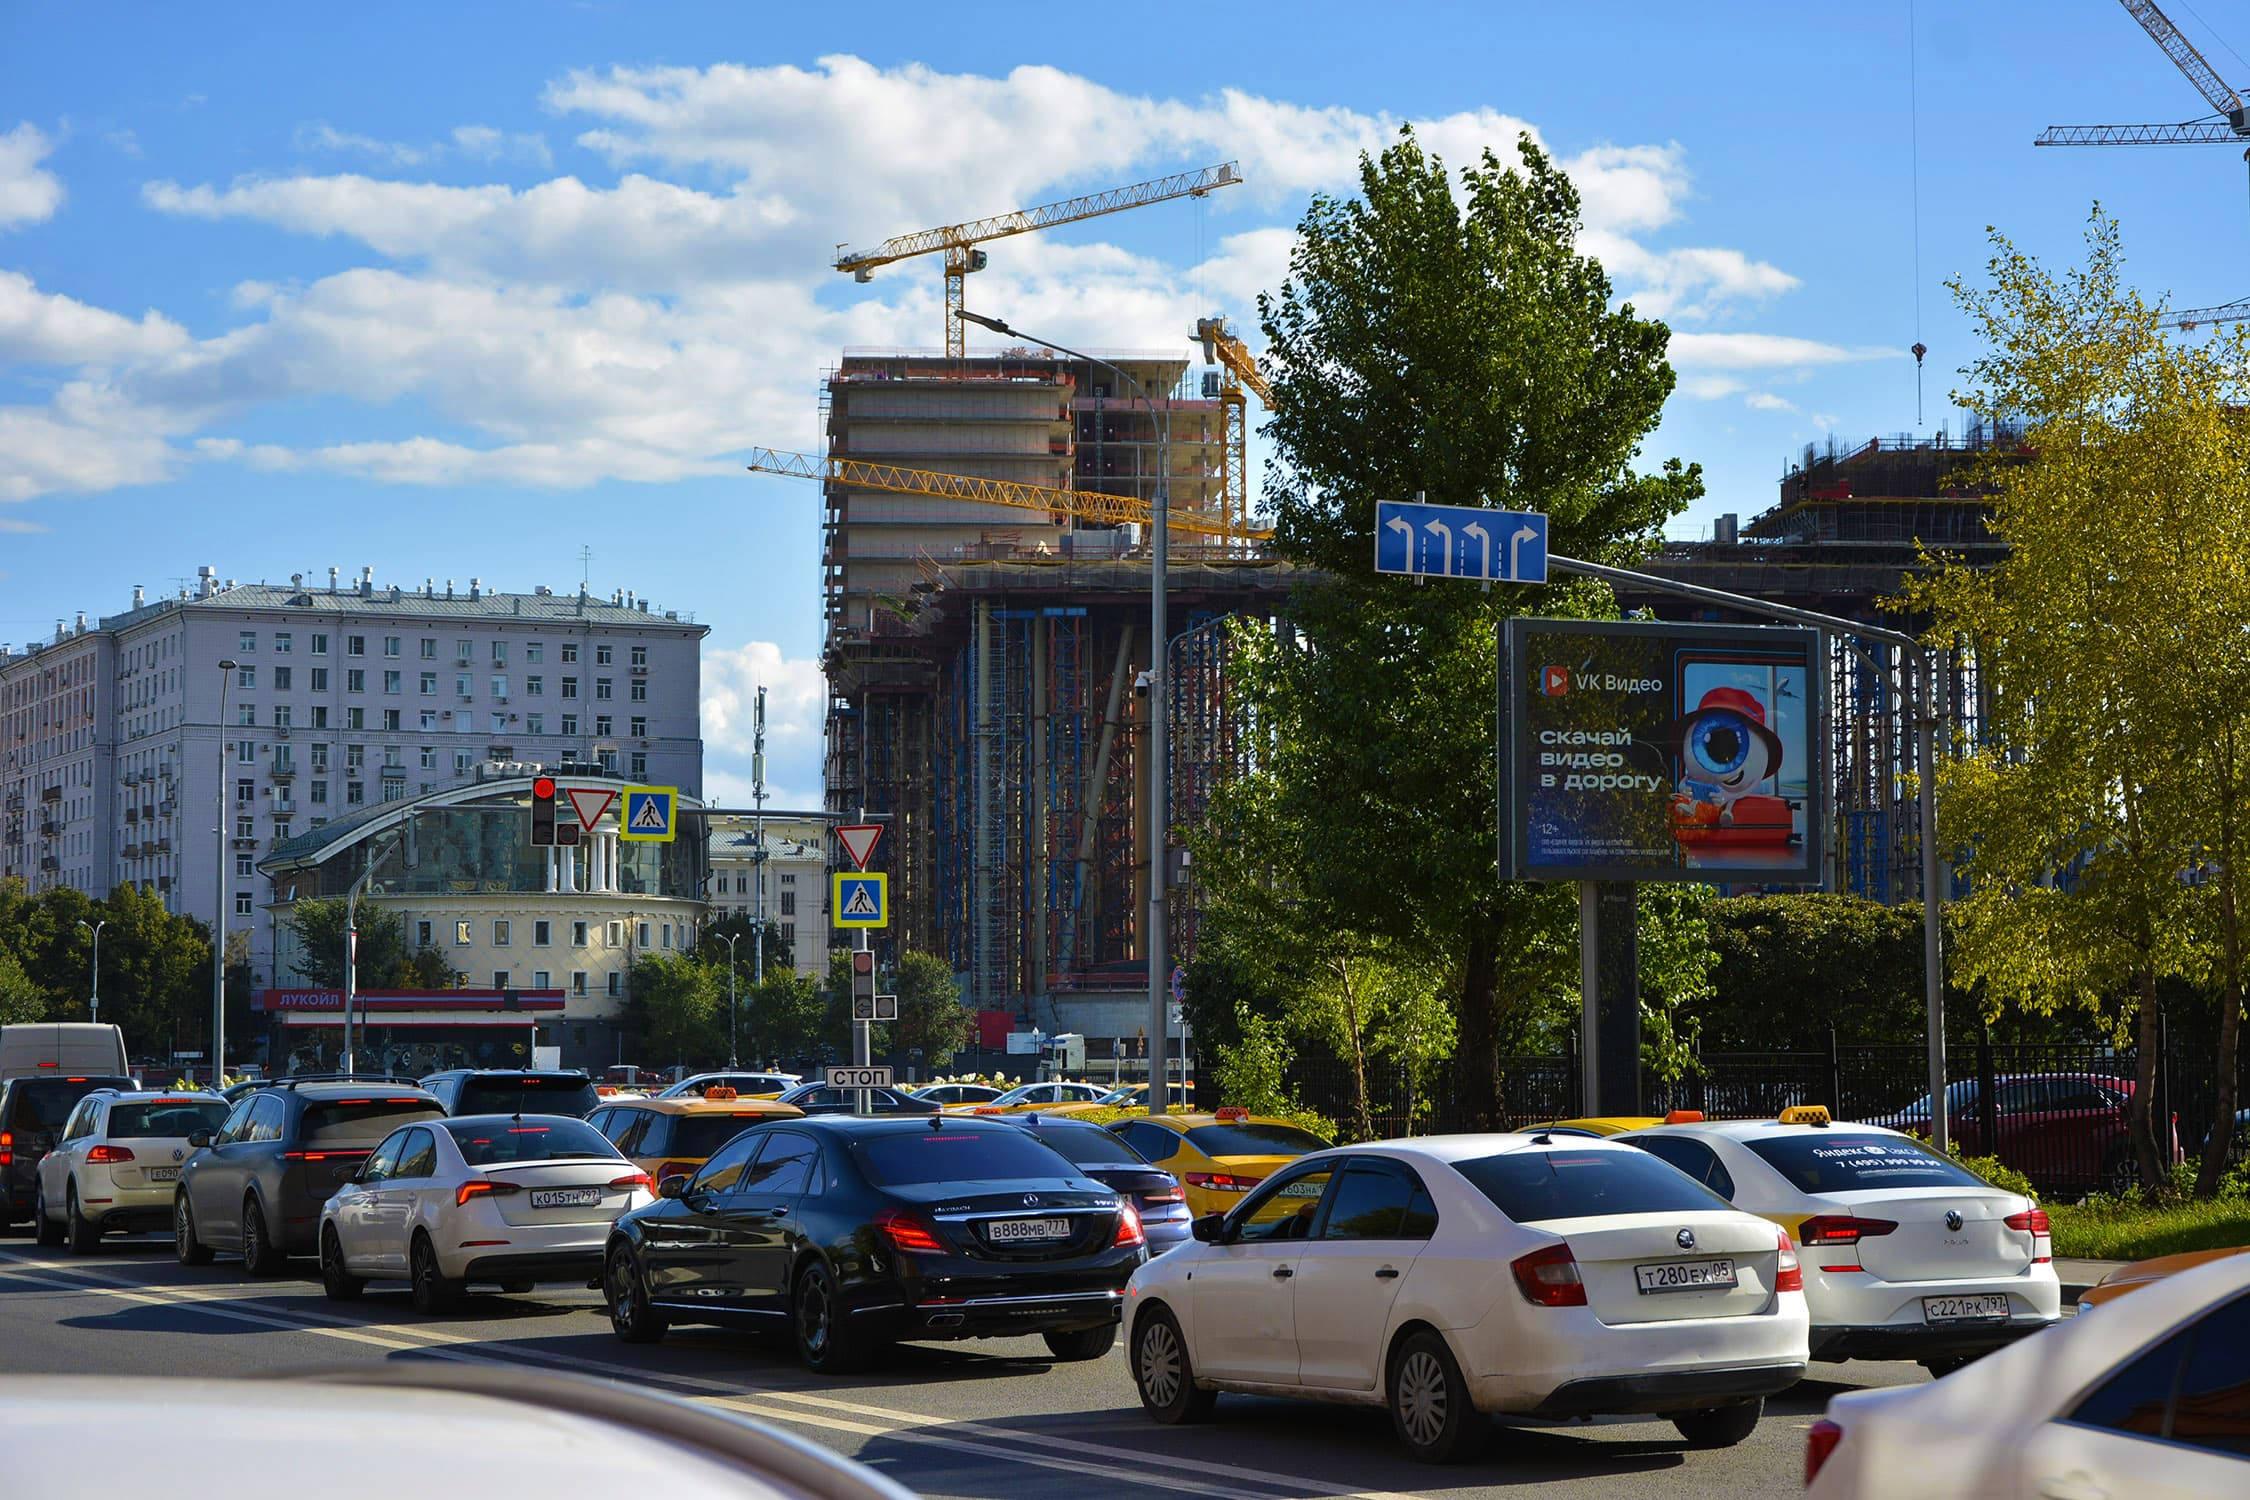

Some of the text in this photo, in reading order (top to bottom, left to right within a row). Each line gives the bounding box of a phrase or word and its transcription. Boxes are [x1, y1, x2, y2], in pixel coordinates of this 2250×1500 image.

[1576, 674, 1663, 694] VK Видео
[1539, 727, 1632, 746] скачай
[1540, 752, 1624, 769] видео
[1540, 774, 1661, 792] в дорогу
[1541, 823, 1560, 835] 12+
[280, 992, 339, 1006] ЛУКОЙЛ
[834, 1070, 885, 1085] СТОП
[1812, 1148, 1868, 1158] Яндекс
